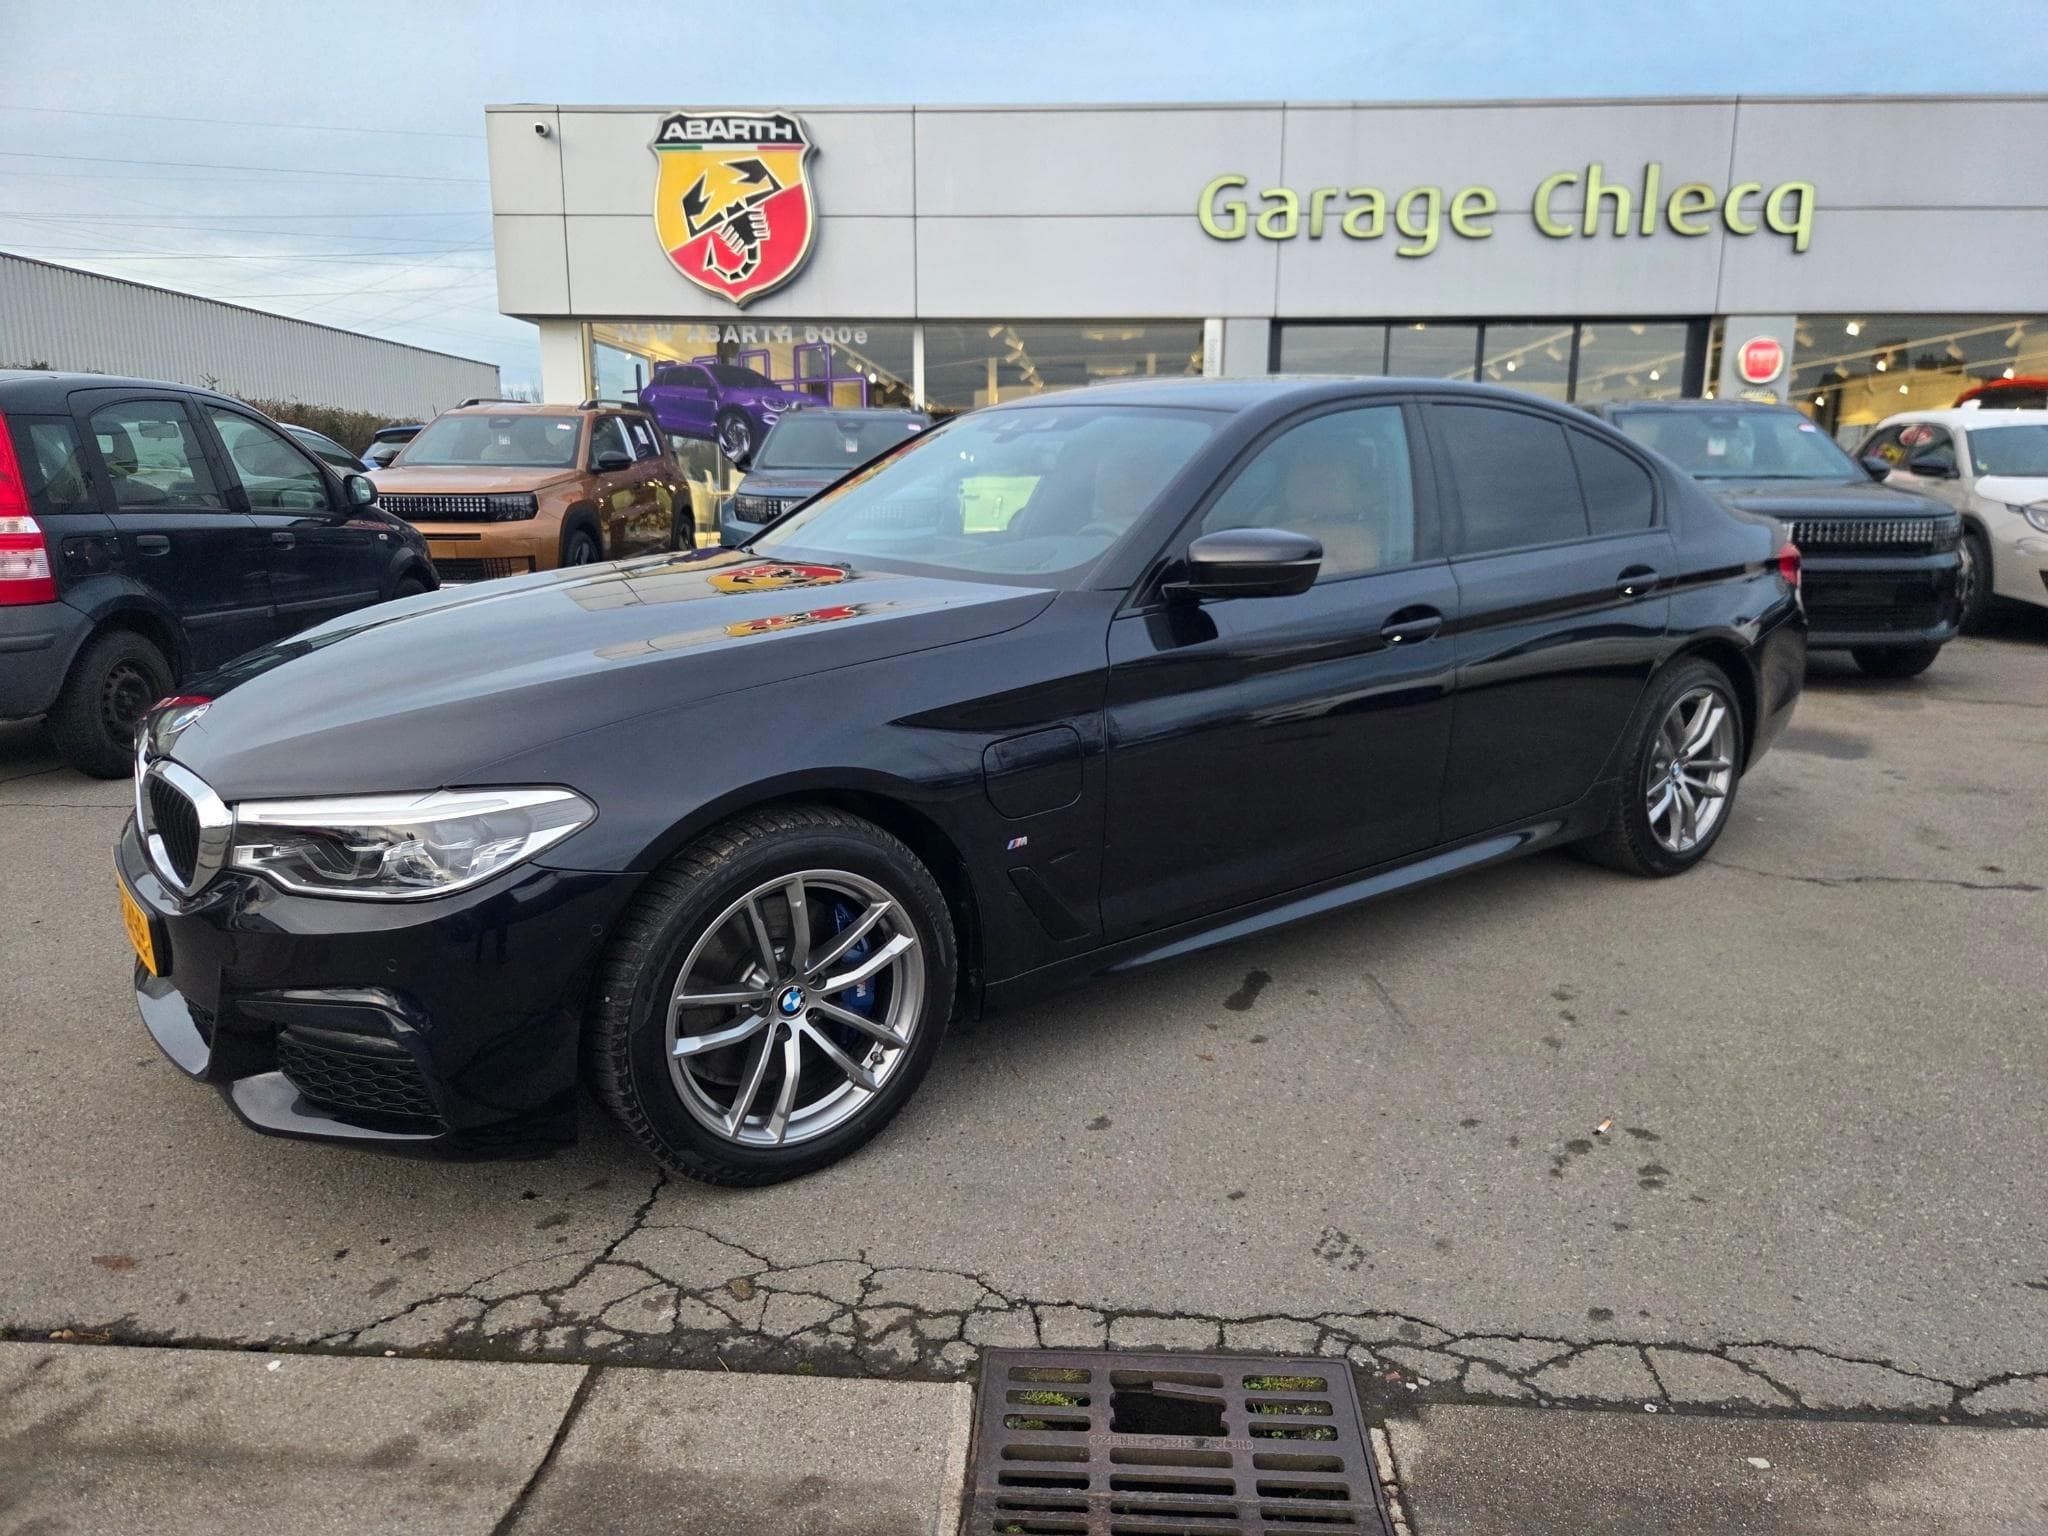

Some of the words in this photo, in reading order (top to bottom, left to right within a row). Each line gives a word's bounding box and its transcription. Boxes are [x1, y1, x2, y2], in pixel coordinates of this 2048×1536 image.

[663, 119, 792, 140] ABARTH
[1198, 173, 1497, 257] Garage
[1532, 161, 1815, 253] Chlecq
[686, 325, 793, 344] ABARTH
